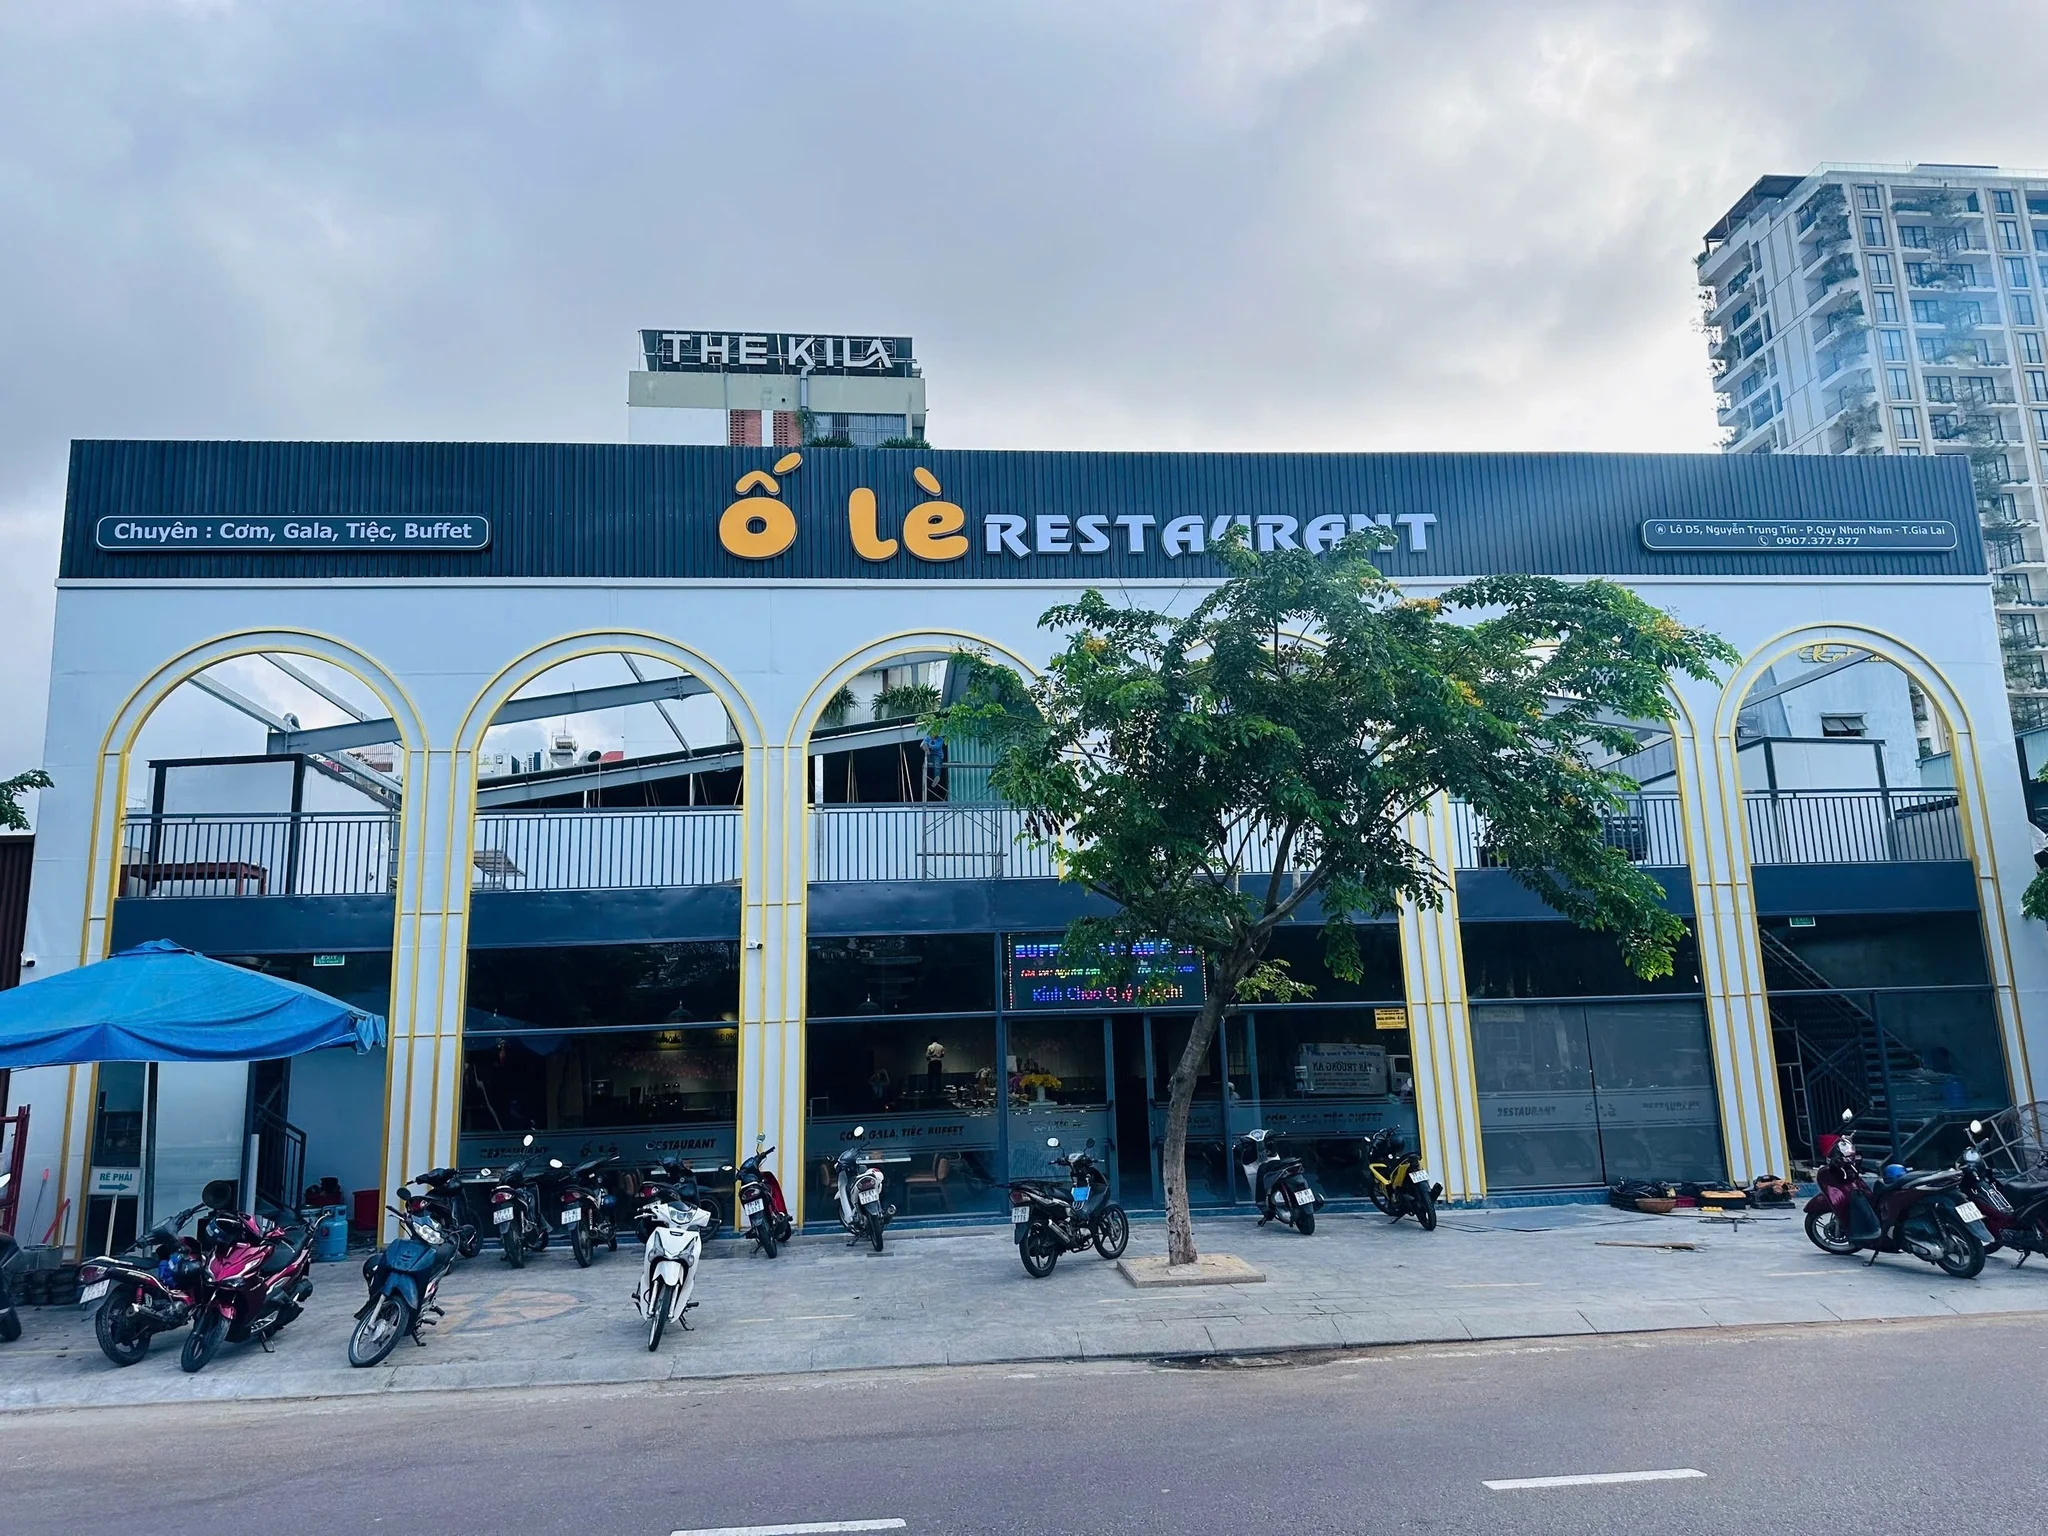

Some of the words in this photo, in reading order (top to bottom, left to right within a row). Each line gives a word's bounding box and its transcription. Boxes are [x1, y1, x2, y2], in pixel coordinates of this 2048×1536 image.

[662, 333, 768, 365] THE
[788, 336, 893, 369] KILA
[114, 521, 198, 543] Chuyên
[219, 522, 276, 542] Cơm,
[283, 521, 339, 542] Gala,
[346, 521, 397, 543] Tiệc,
[404, 522, 472, 539] Buffet
[1670, 524, 1683, 534] Lô
[1685, 525, 1703, 536] D5,
[1706, 522, 1745, 536] Nguyễn
[1747, 525, 1778, 536] Trung
[1780, 524, 1797, 534] Tín
[1806, 525, 1836, 536] P.Quy
[1839, 525, 1867, 535] Nhơn
[1869, 525, 1892, 535] Nam
[1901, 525, 1928, 535] T.Gia
[1930, 525, 1945, 535] Lai
[1776, 536, 1859, 545] 0907.377.877
[649, 1136, 717, 1150] ESTAURANT
